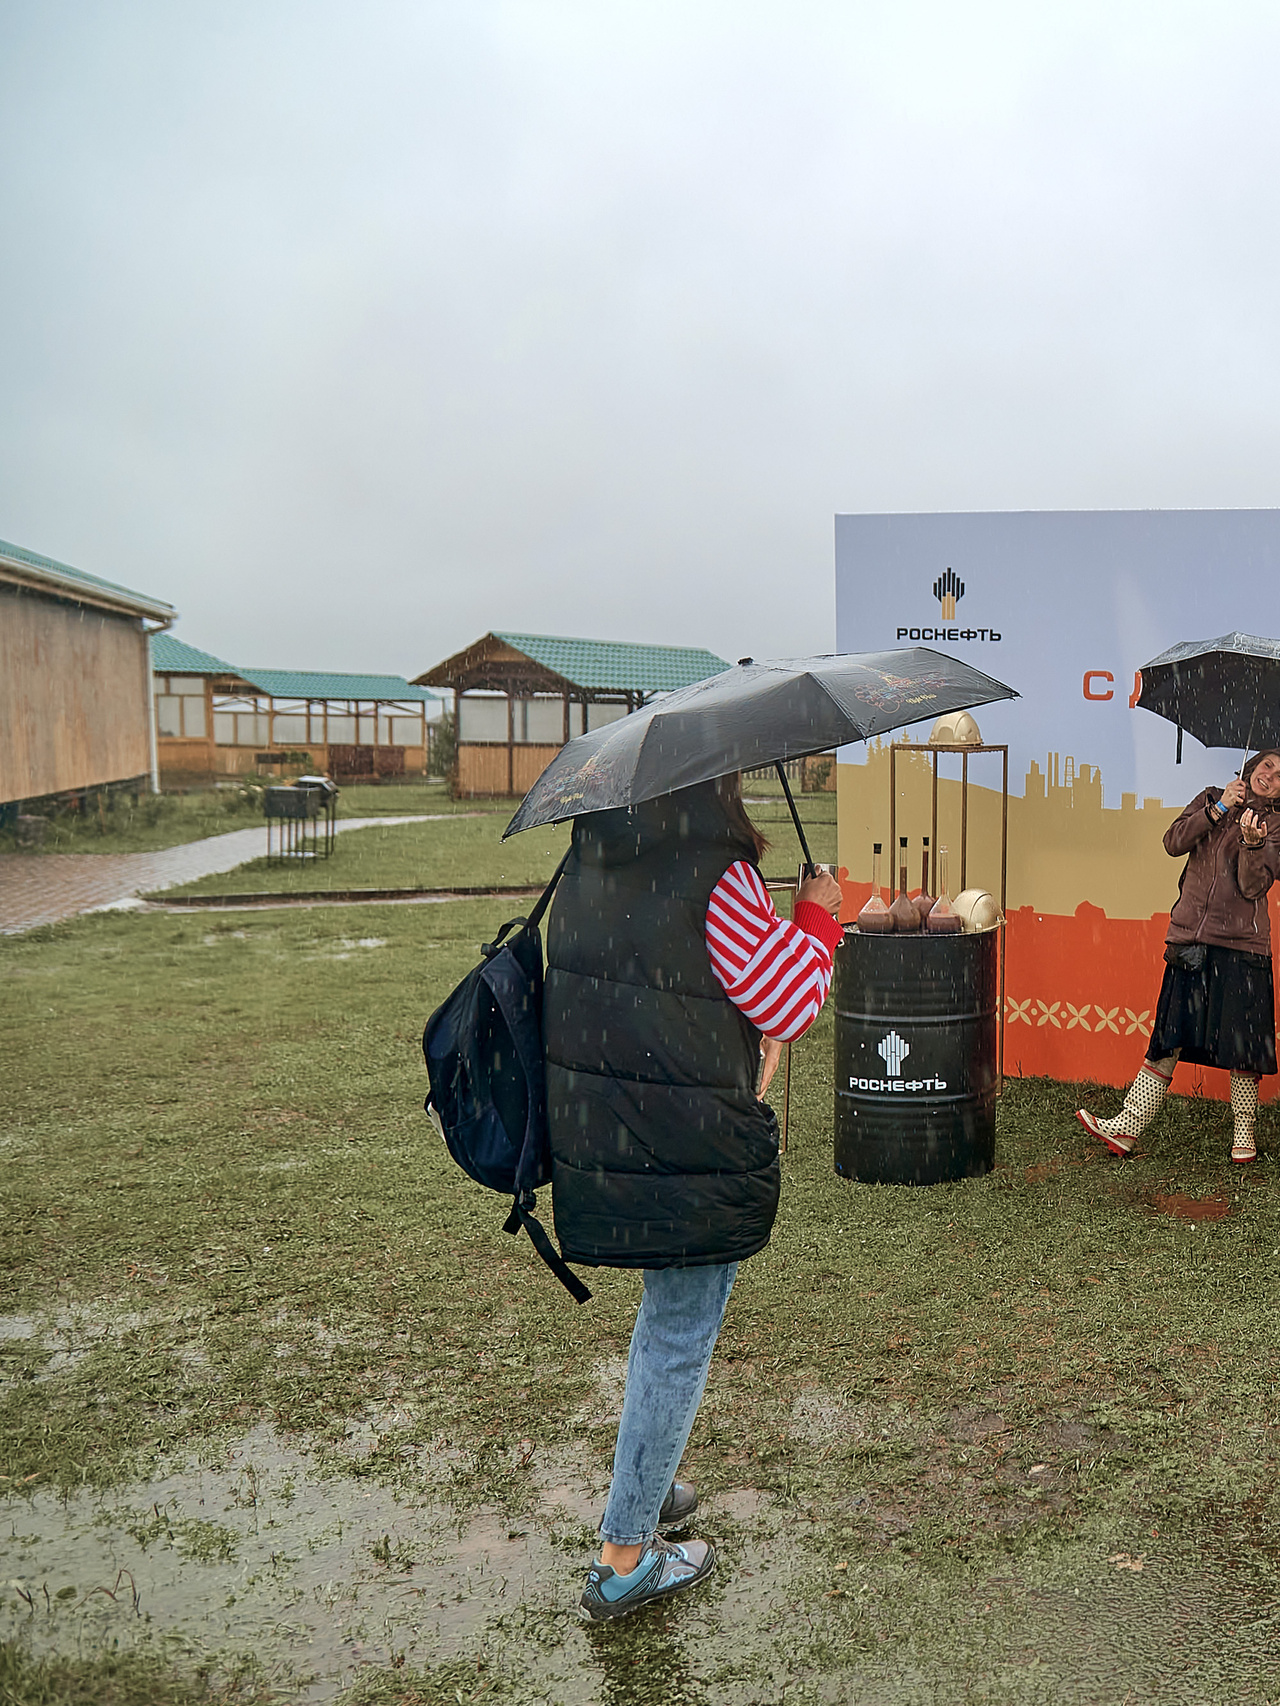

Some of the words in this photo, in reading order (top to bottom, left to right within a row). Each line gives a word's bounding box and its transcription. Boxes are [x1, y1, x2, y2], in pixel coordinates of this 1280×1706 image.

[896, 627, 1002, 642] РОСНЕФТЬ
[1082, 670, 1115, 701] С
[849, 1076, 948, 1092] РОСНЕФТЬ
